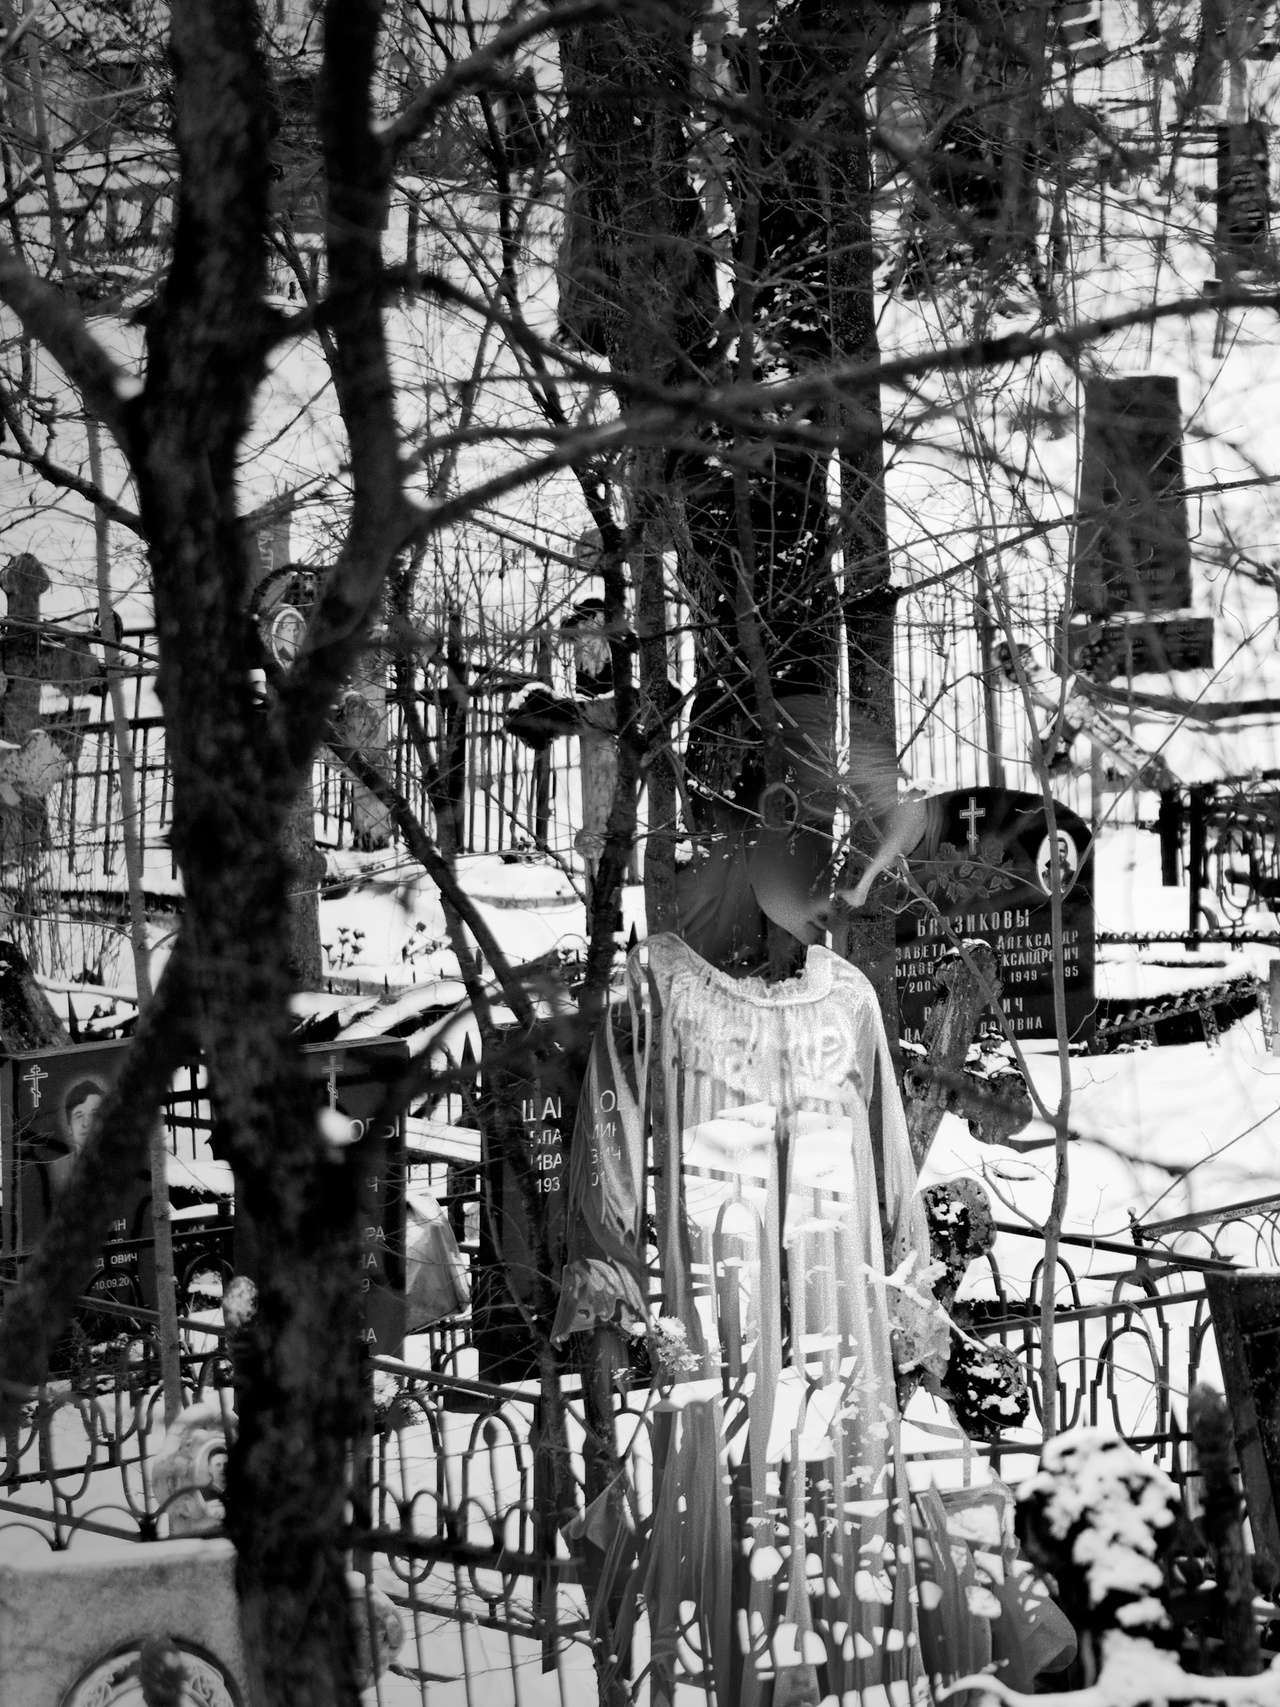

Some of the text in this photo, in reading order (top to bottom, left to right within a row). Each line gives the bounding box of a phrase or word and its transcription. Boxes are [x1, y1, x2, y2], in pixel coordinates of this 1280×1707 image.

[996, 930, 1078, 950] АЛЕКСАДР
[997, 946, 1078, 967] КСАНДРЕИЧ
[1011, 969, 1038, 983] 1949
[909, 980, 937, 994] 200
